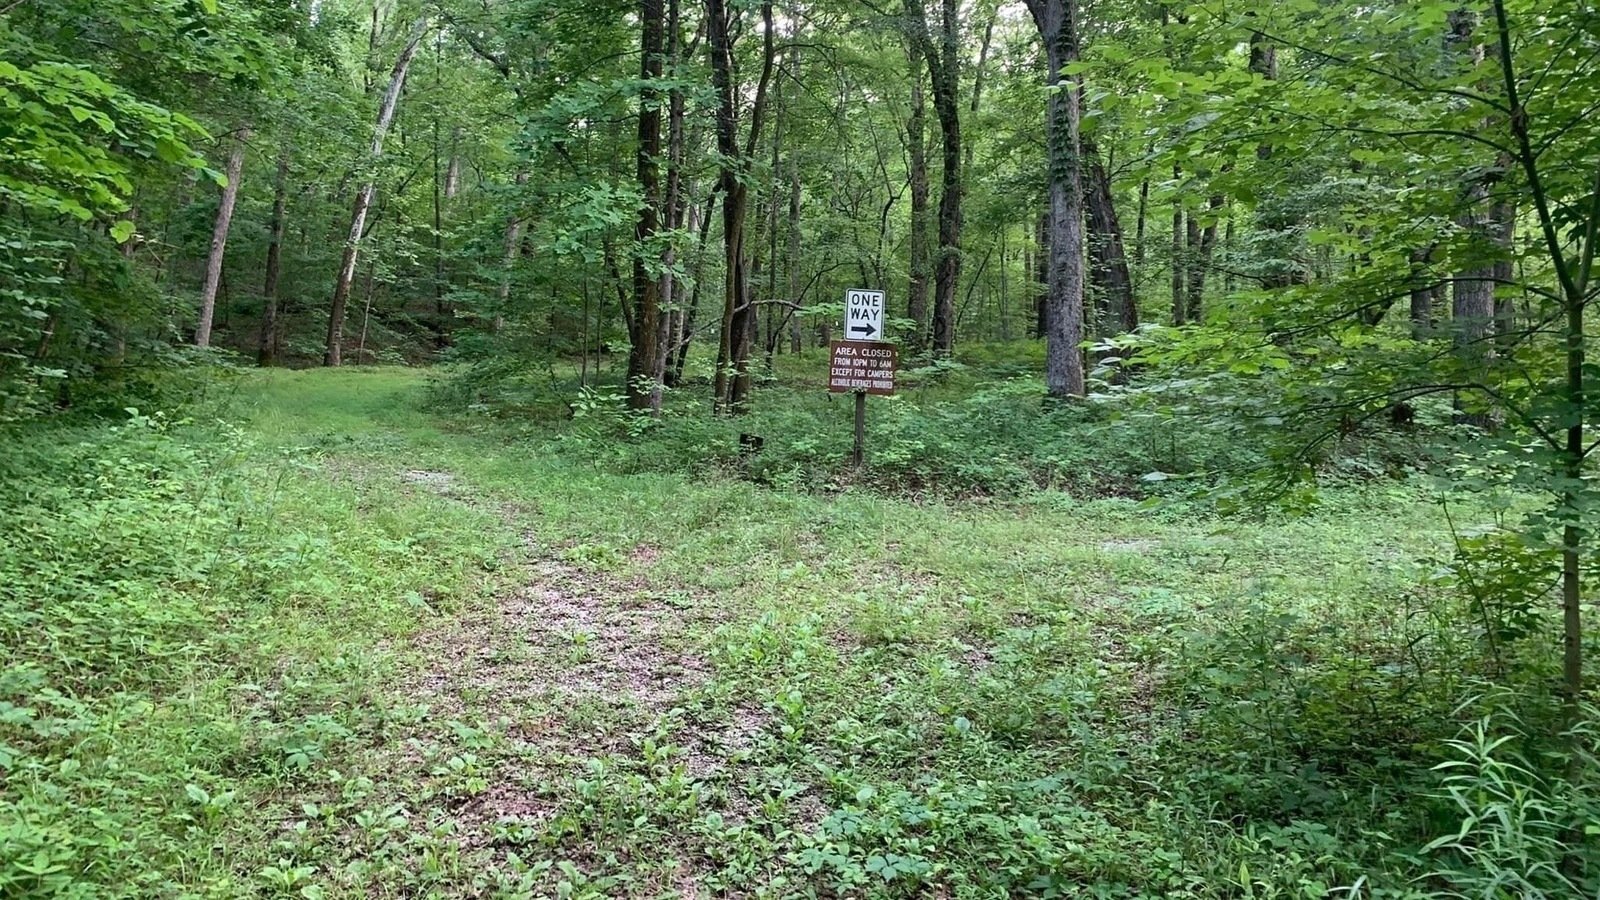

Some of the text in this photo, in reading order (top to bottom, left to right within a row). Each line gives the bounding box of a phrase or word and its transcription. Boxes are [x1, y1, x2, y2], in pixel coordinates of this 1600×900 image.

[852, 294, 880, 306] ONE
[851, 308, 880, 321] WAY
[835, 347, 892, 357] AREA CLOSED
[834, 357, 892, 368] FROM 10PM TO 6AM
[831, 367, 893, 379] EXCEPT FOR CAMPERS
